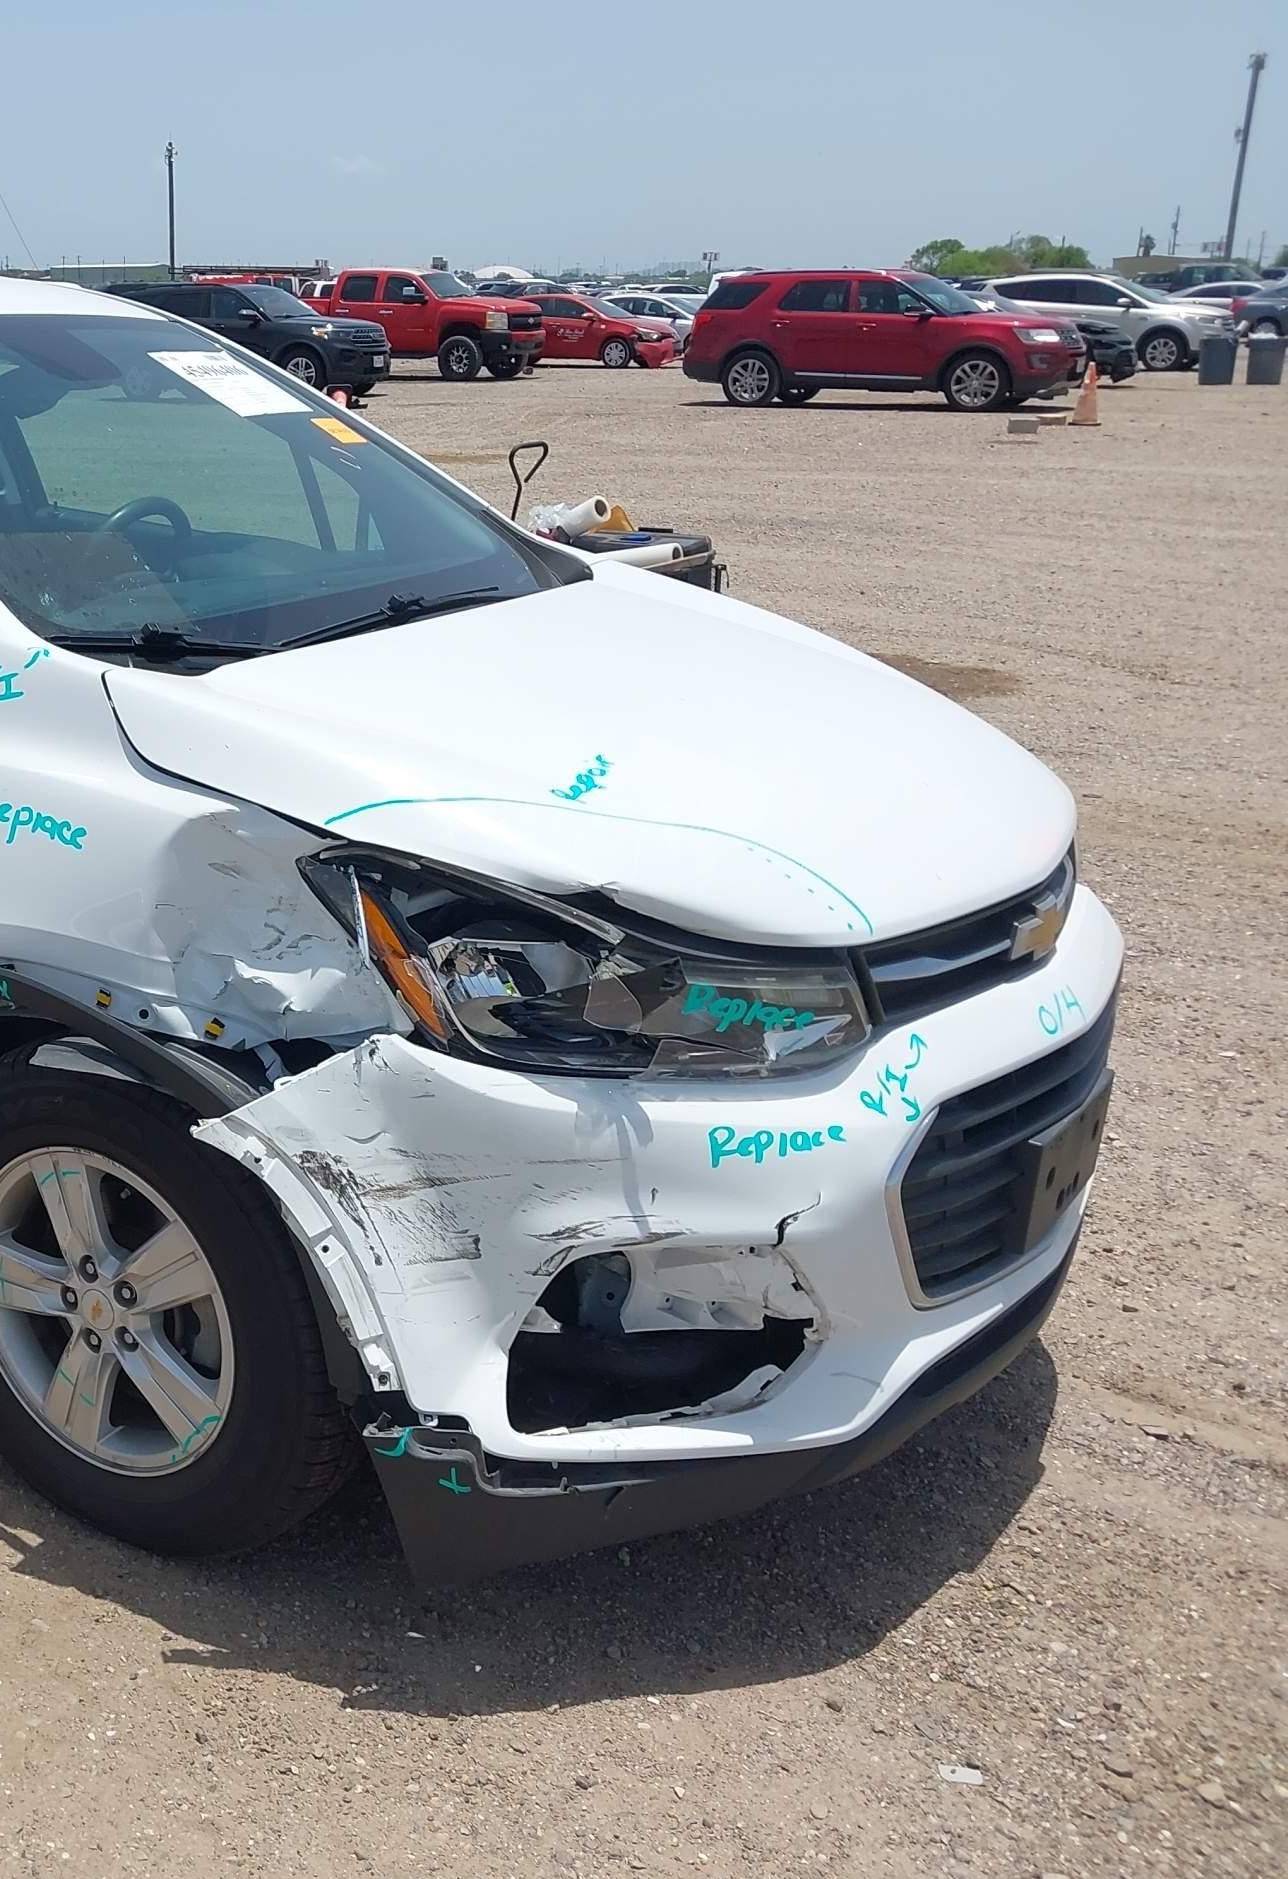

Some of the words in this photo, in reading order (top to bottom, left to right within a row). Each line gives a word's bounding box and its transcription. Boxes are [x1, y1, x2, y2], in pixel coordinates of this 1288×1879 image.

[682, 982, 816, 1032] Replace
[860, 1064, 908, 1116] R/I
[708, 1125, 847, 1168] Replace
